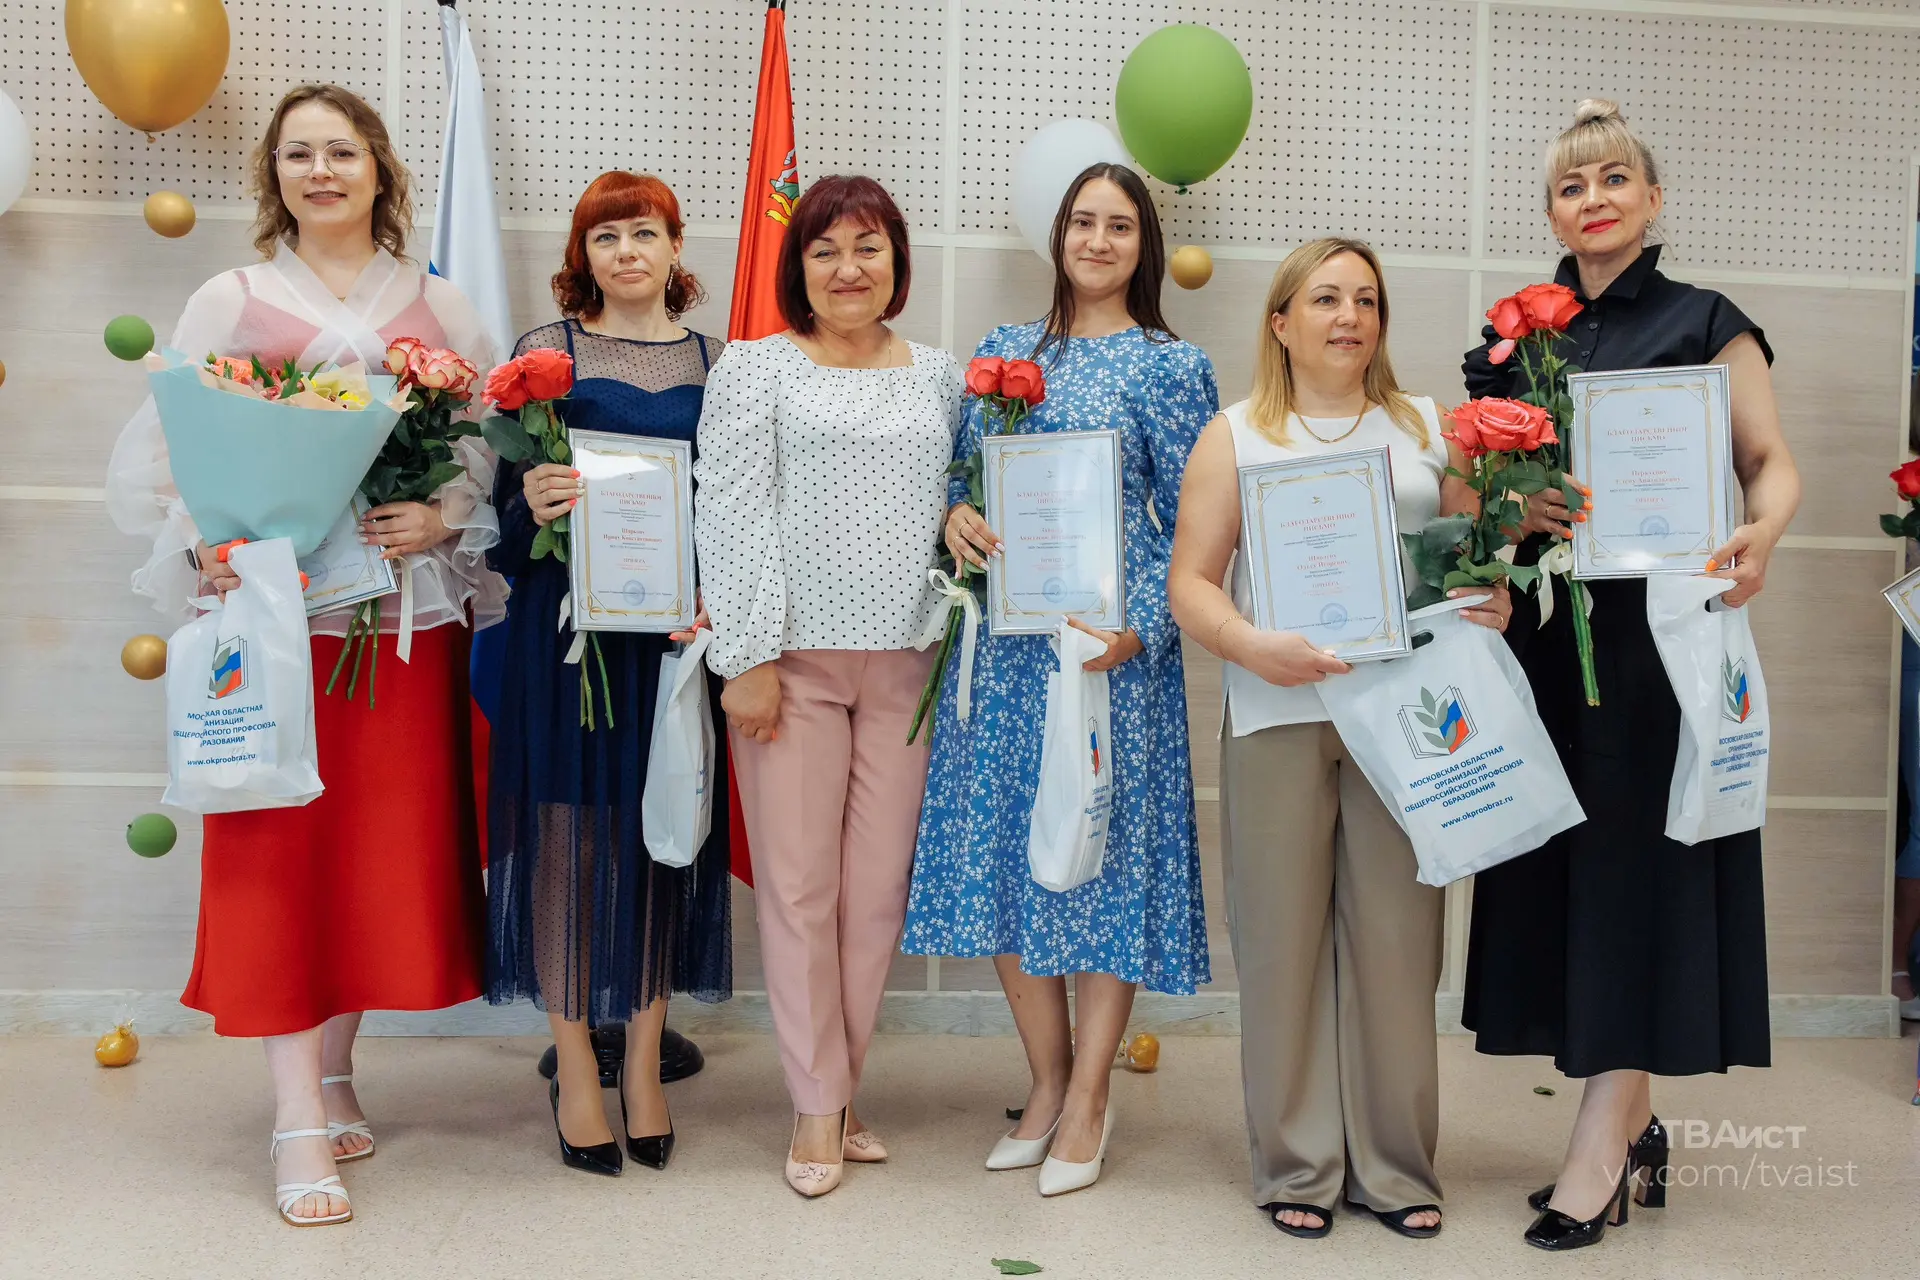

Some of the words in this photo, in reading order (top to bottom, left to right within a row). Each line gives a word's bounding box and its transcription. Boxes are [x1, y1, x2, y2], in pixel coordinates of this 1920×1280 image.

[222, 704, 263, 716] ОБЛАСТНАЯ
[232, 721, 276, 734] ПРОФСОЮЗА
[187, 753, 256, 766] www.okproobraz.ru
[1409, 763, 1460, 790] МОСКОВСКАЯ
[1460, 745, 1505, 770] ОБЛАСТНАЯ
[1404, 778, 1478, 813] ОБЩЕРОССИЙСКОГО
[1478, 758, 1525, 785] ПРОФСОЮЗА
[1434, 763, 1487, 790] ОРГАНИЗАЦИЯ
[1442, 781, 1496, 808] ОБРАЗОВАНИЯ
[1440, 796, 1514, 829] www.okproobraz.ru
